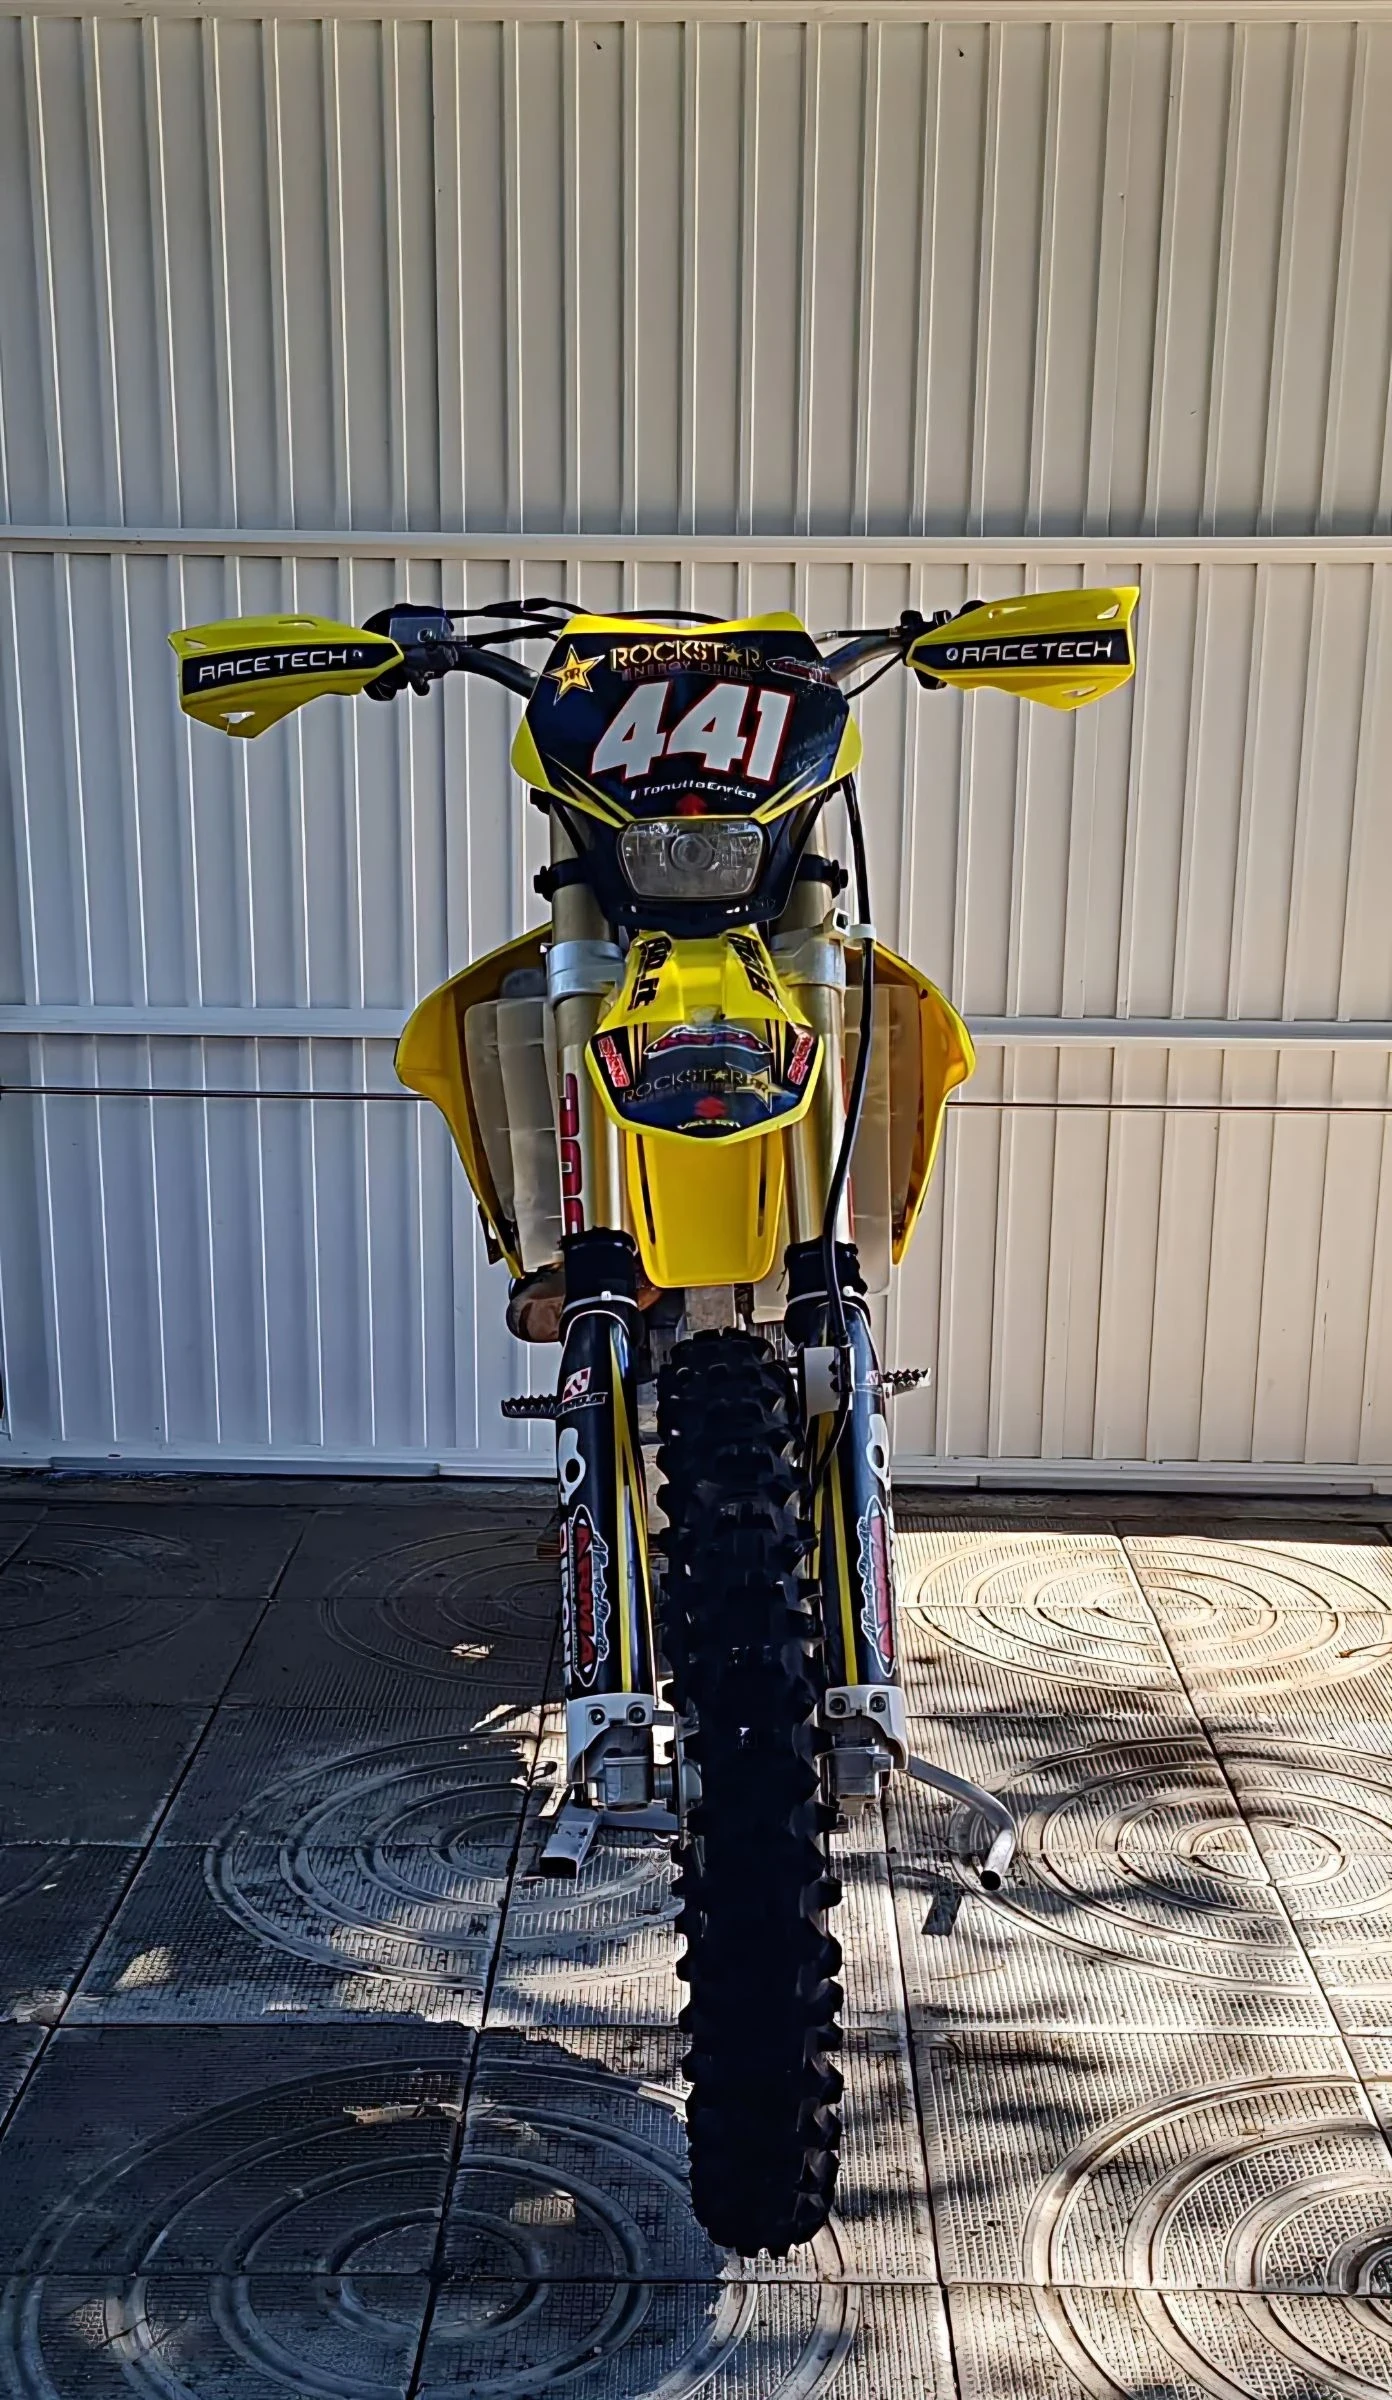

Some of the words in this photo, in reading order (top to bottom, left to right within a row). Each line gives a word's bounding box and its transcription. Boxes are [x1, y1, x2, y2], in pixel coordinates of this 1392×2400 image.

[199, 649, 347, 683] RACETECH
[962, 641, 1113, 664] RACETECH
[592, 680, 796, 783] 441
